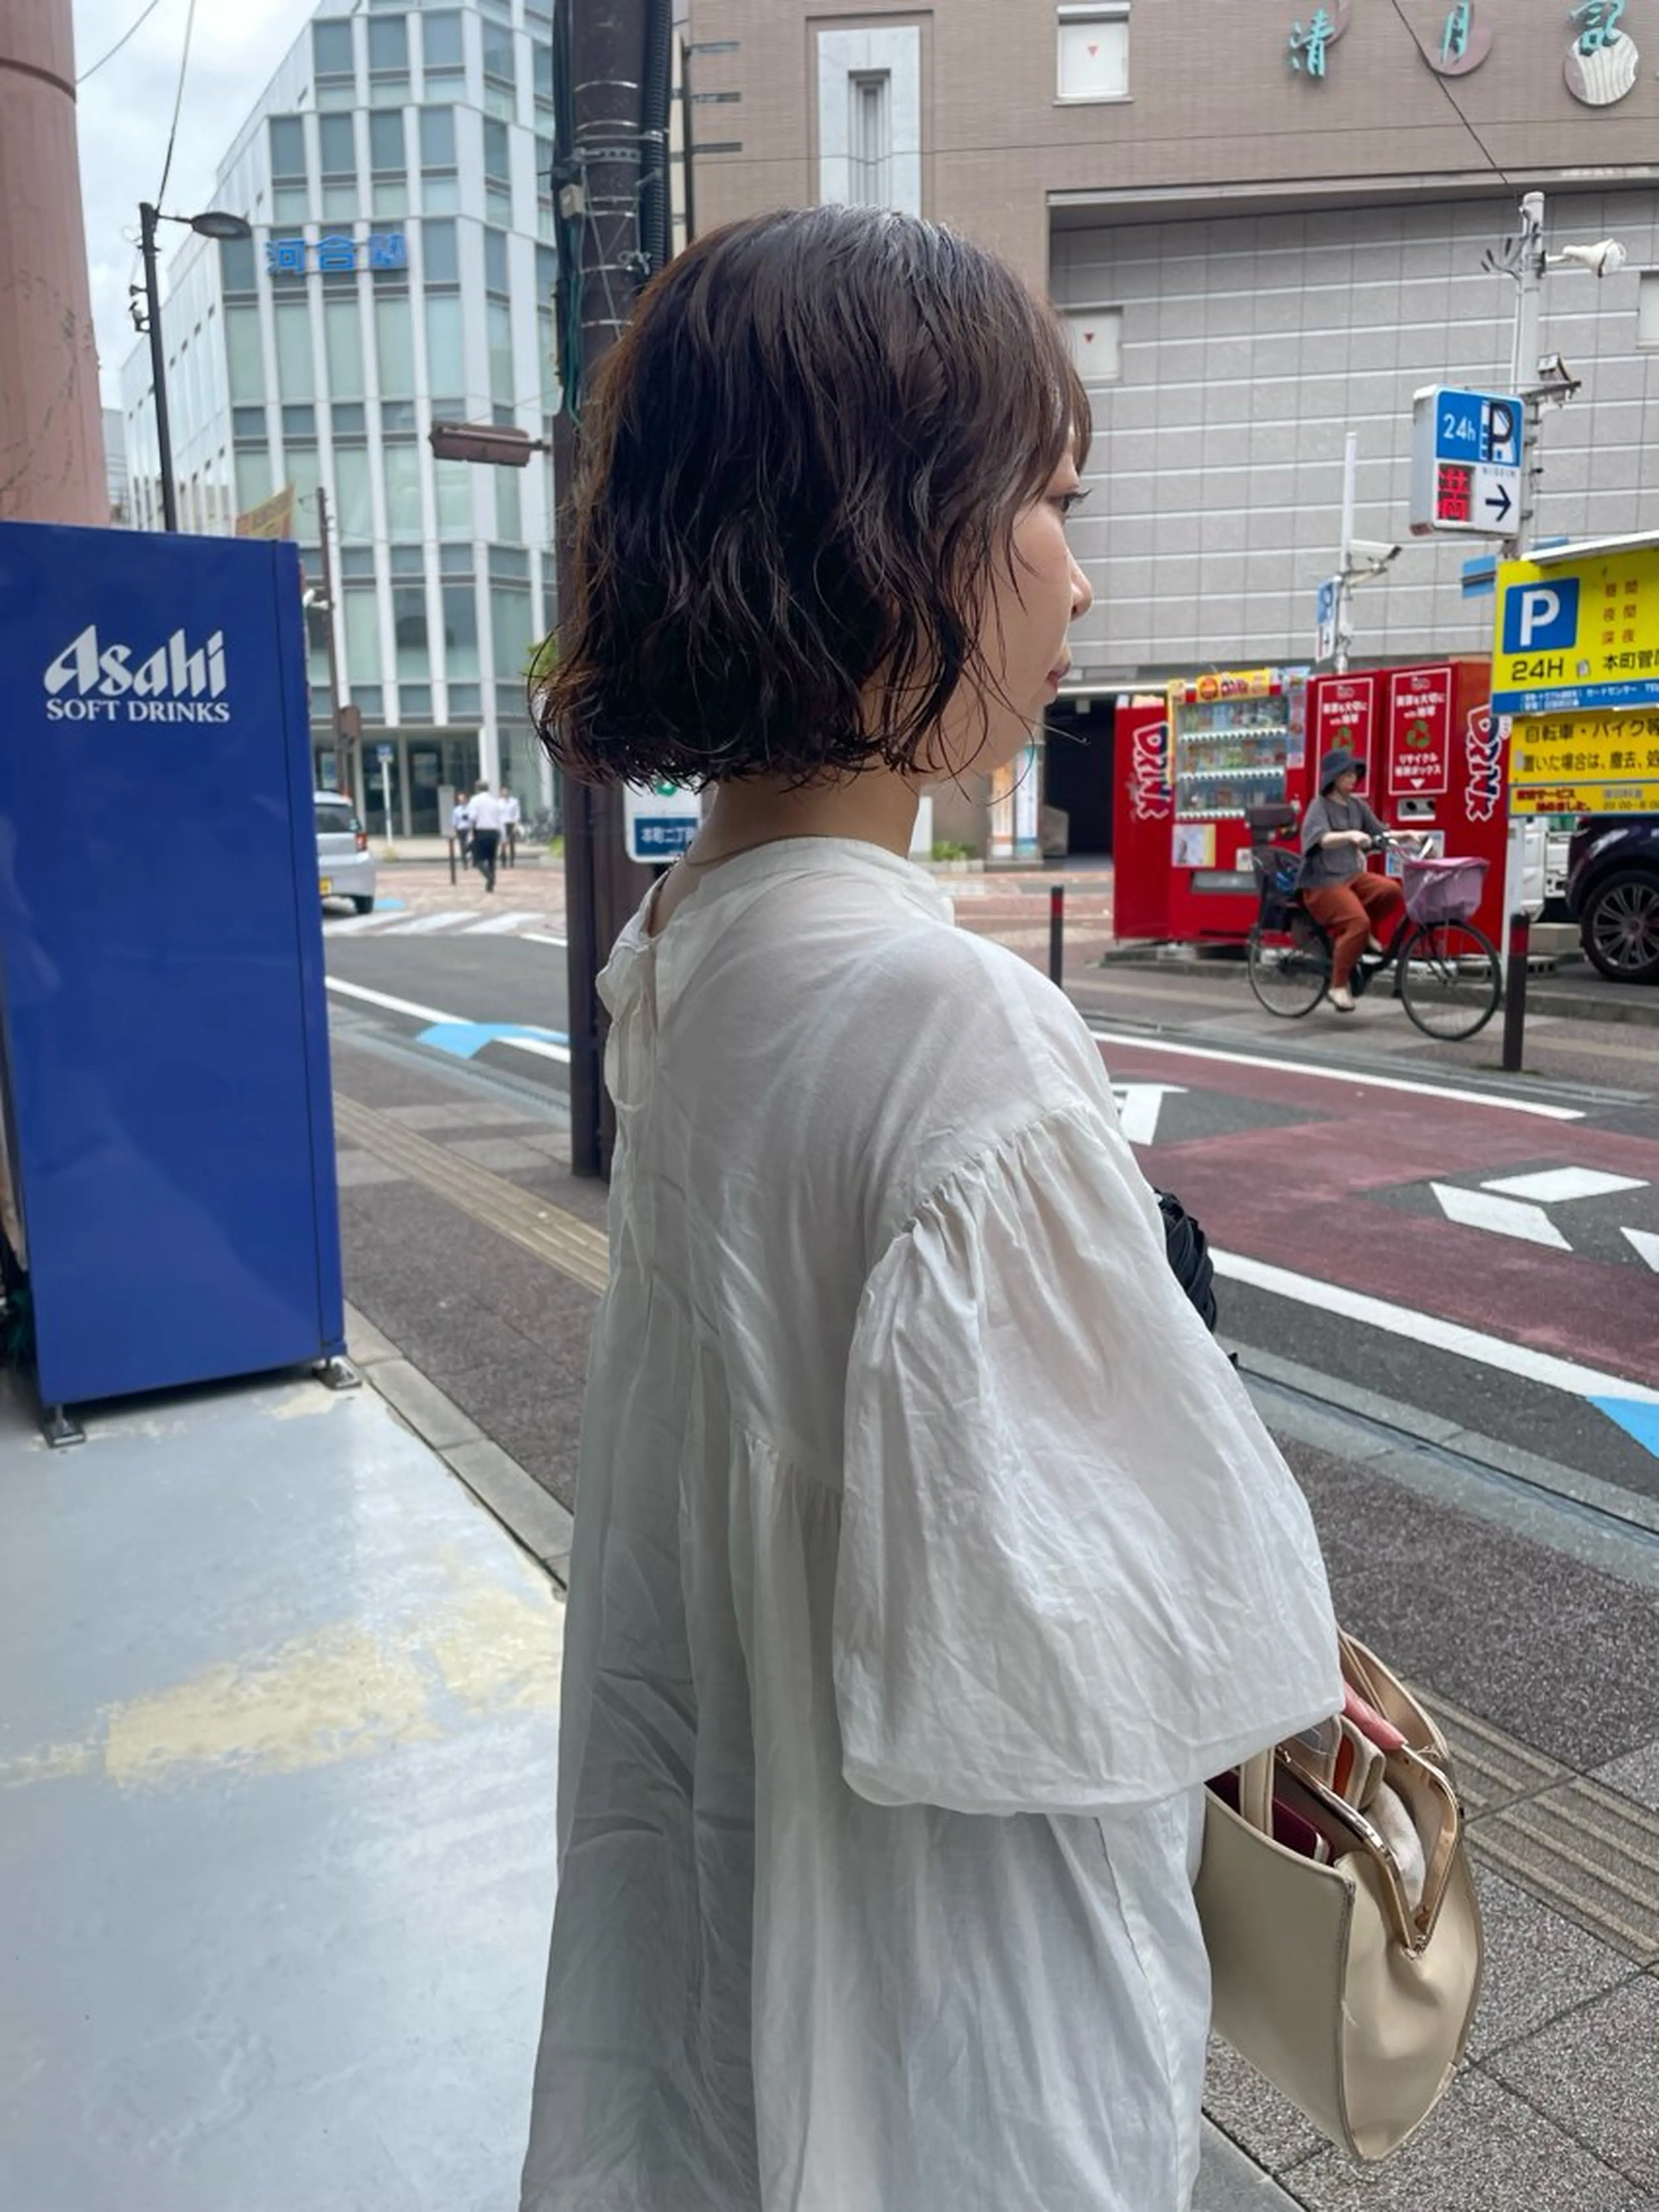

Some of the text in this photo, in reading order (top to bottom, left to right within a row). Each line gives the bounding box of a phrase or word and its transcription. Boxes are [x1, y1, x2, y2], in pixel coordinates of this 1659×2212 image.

[1443, 413, 1476, 442] 24h
[1519, 588, 1560, 647] P
[44, 623, 227, 699] Asahi
[1511, 657, 1564, 682] 24H
[1602, 649, 1659, 672] 本町管
[46, 698, 231, 723] SOFT DRINKS
